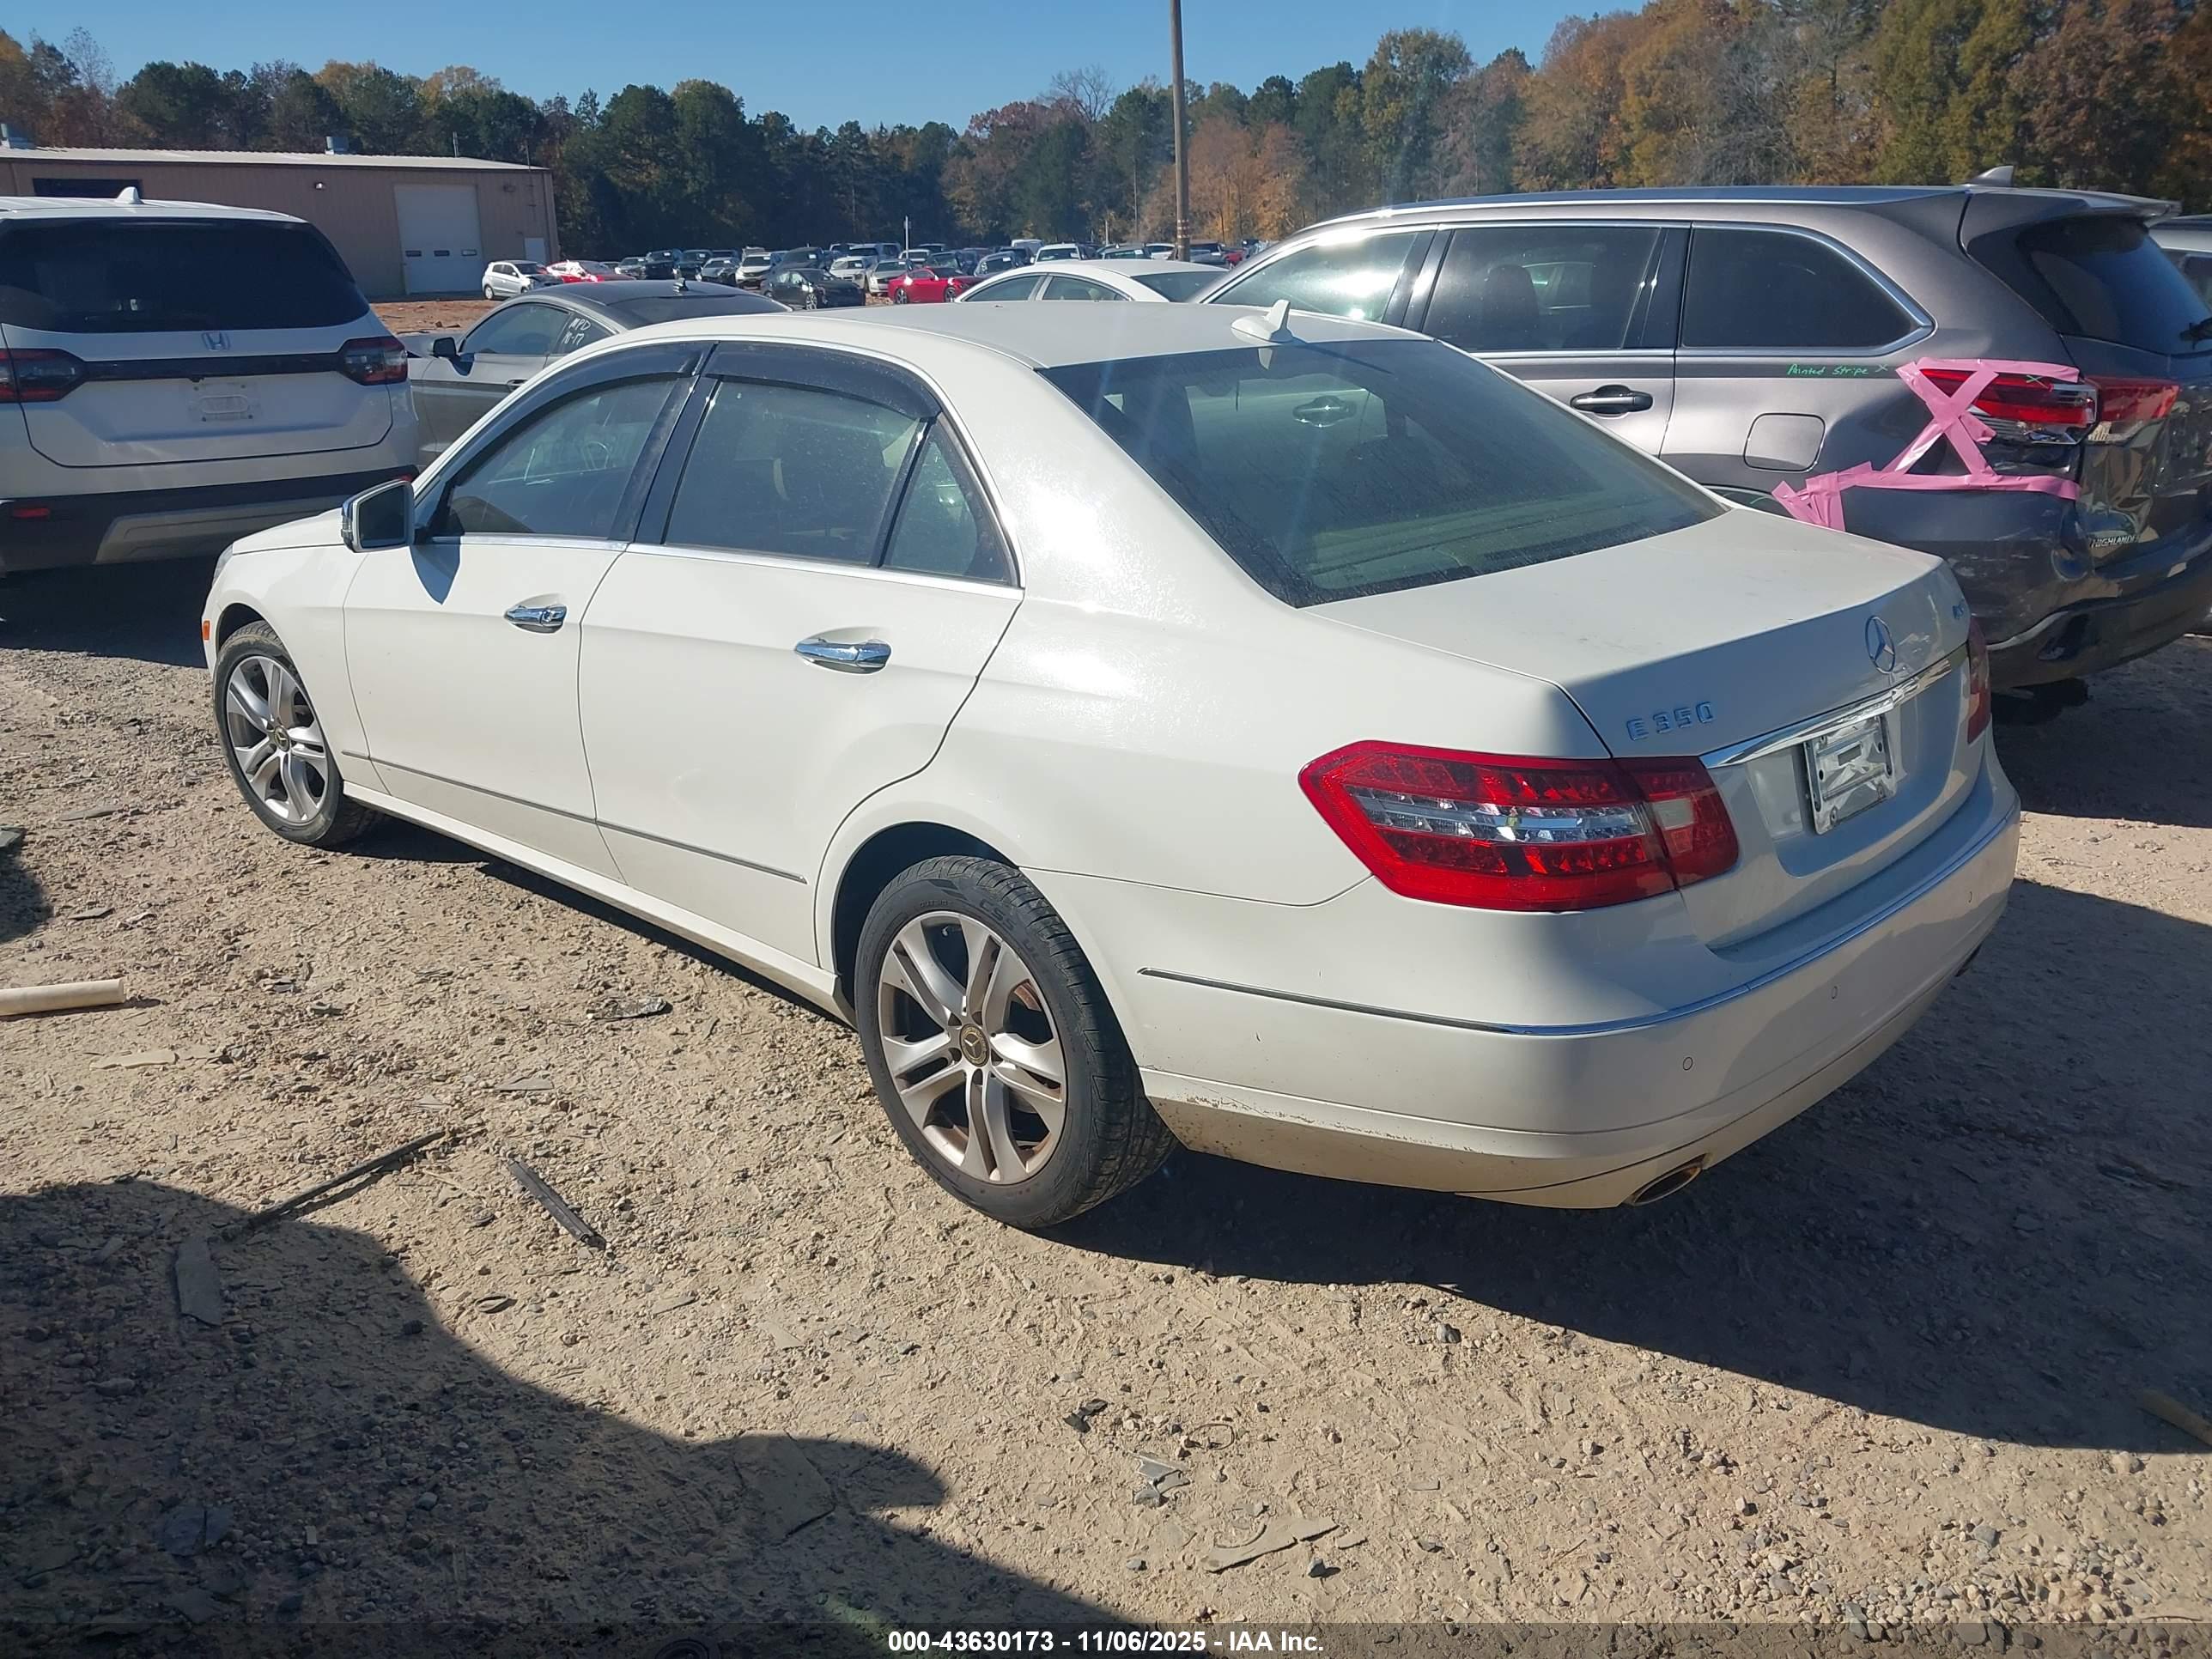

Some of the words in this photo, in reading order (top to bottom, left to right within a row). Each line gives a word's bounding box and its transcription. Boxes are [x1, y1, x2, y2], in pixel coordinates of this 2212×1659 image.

[1787, 363, 1826, 375] Painted
[1626, 717, 1650, 742] E
[1652, 701, 1716, 734] 350
